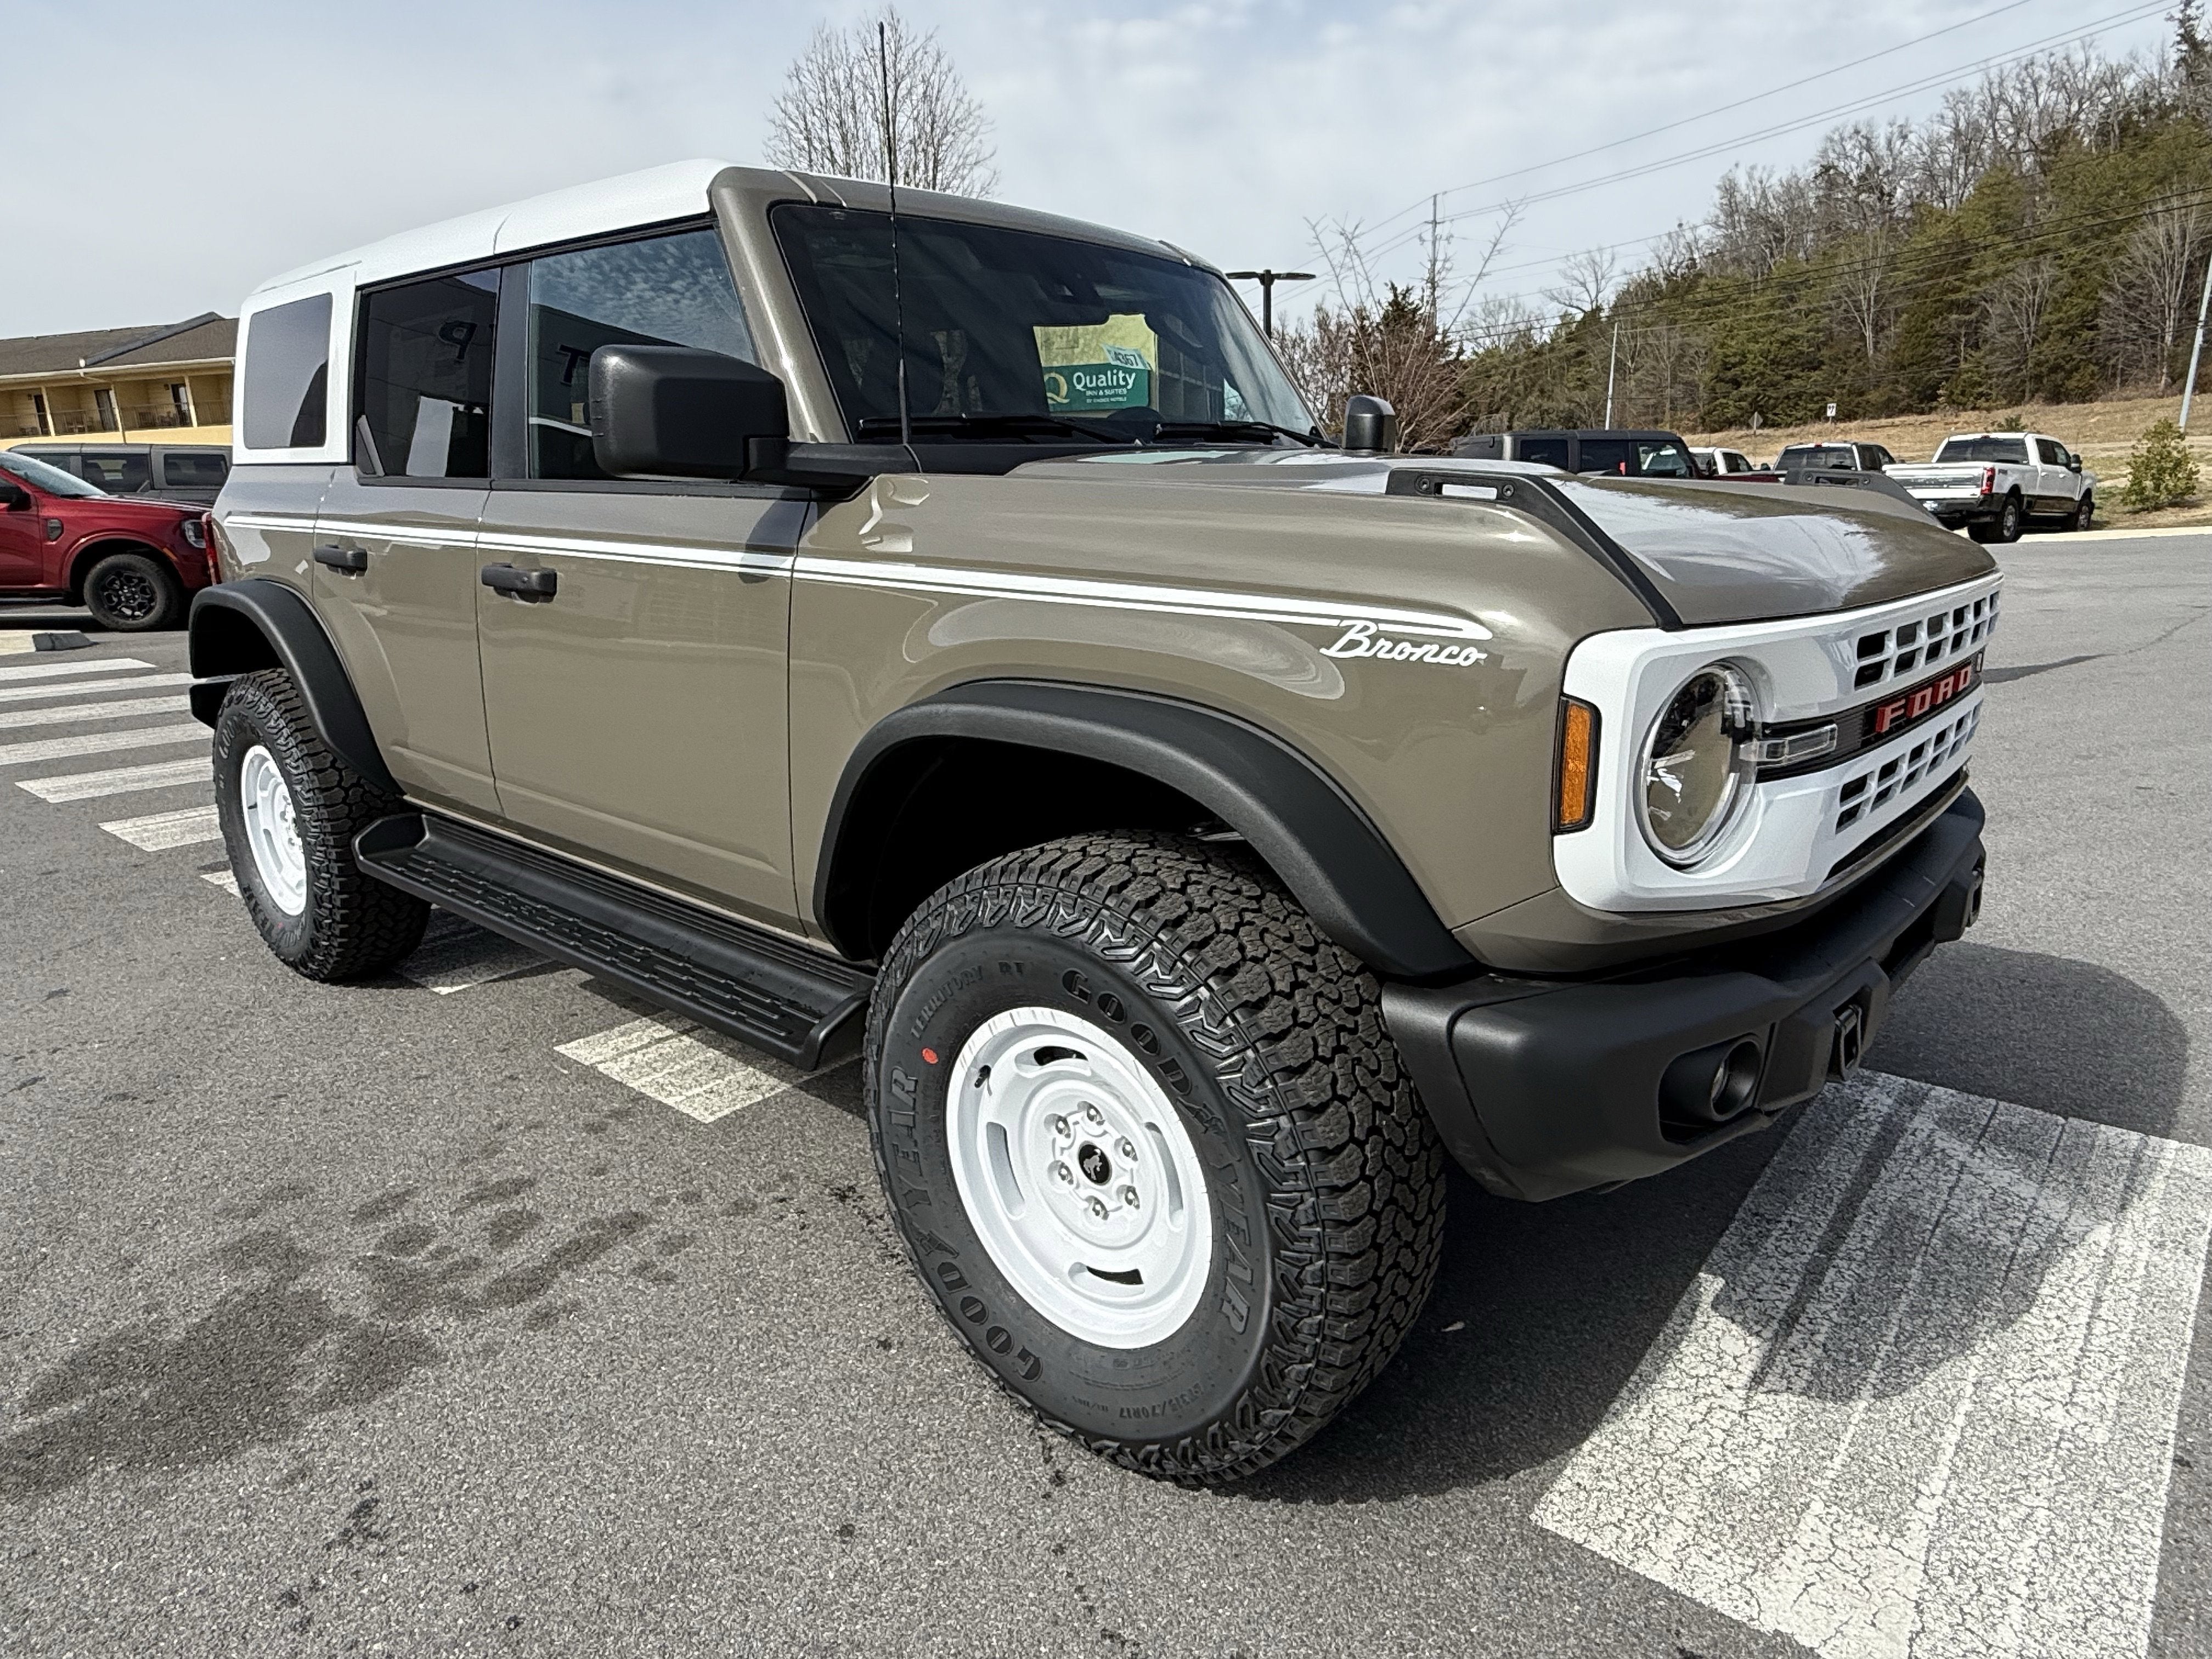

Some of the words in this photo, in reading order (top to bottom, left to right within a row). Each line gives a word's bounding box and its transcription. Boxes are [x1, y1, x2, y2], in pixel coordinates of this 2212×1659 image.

[1073, 369, 1136, 391] Quality
[1319, 619, 1488, 667] Bronco
[1875, 665, 1972, 733] FORD
